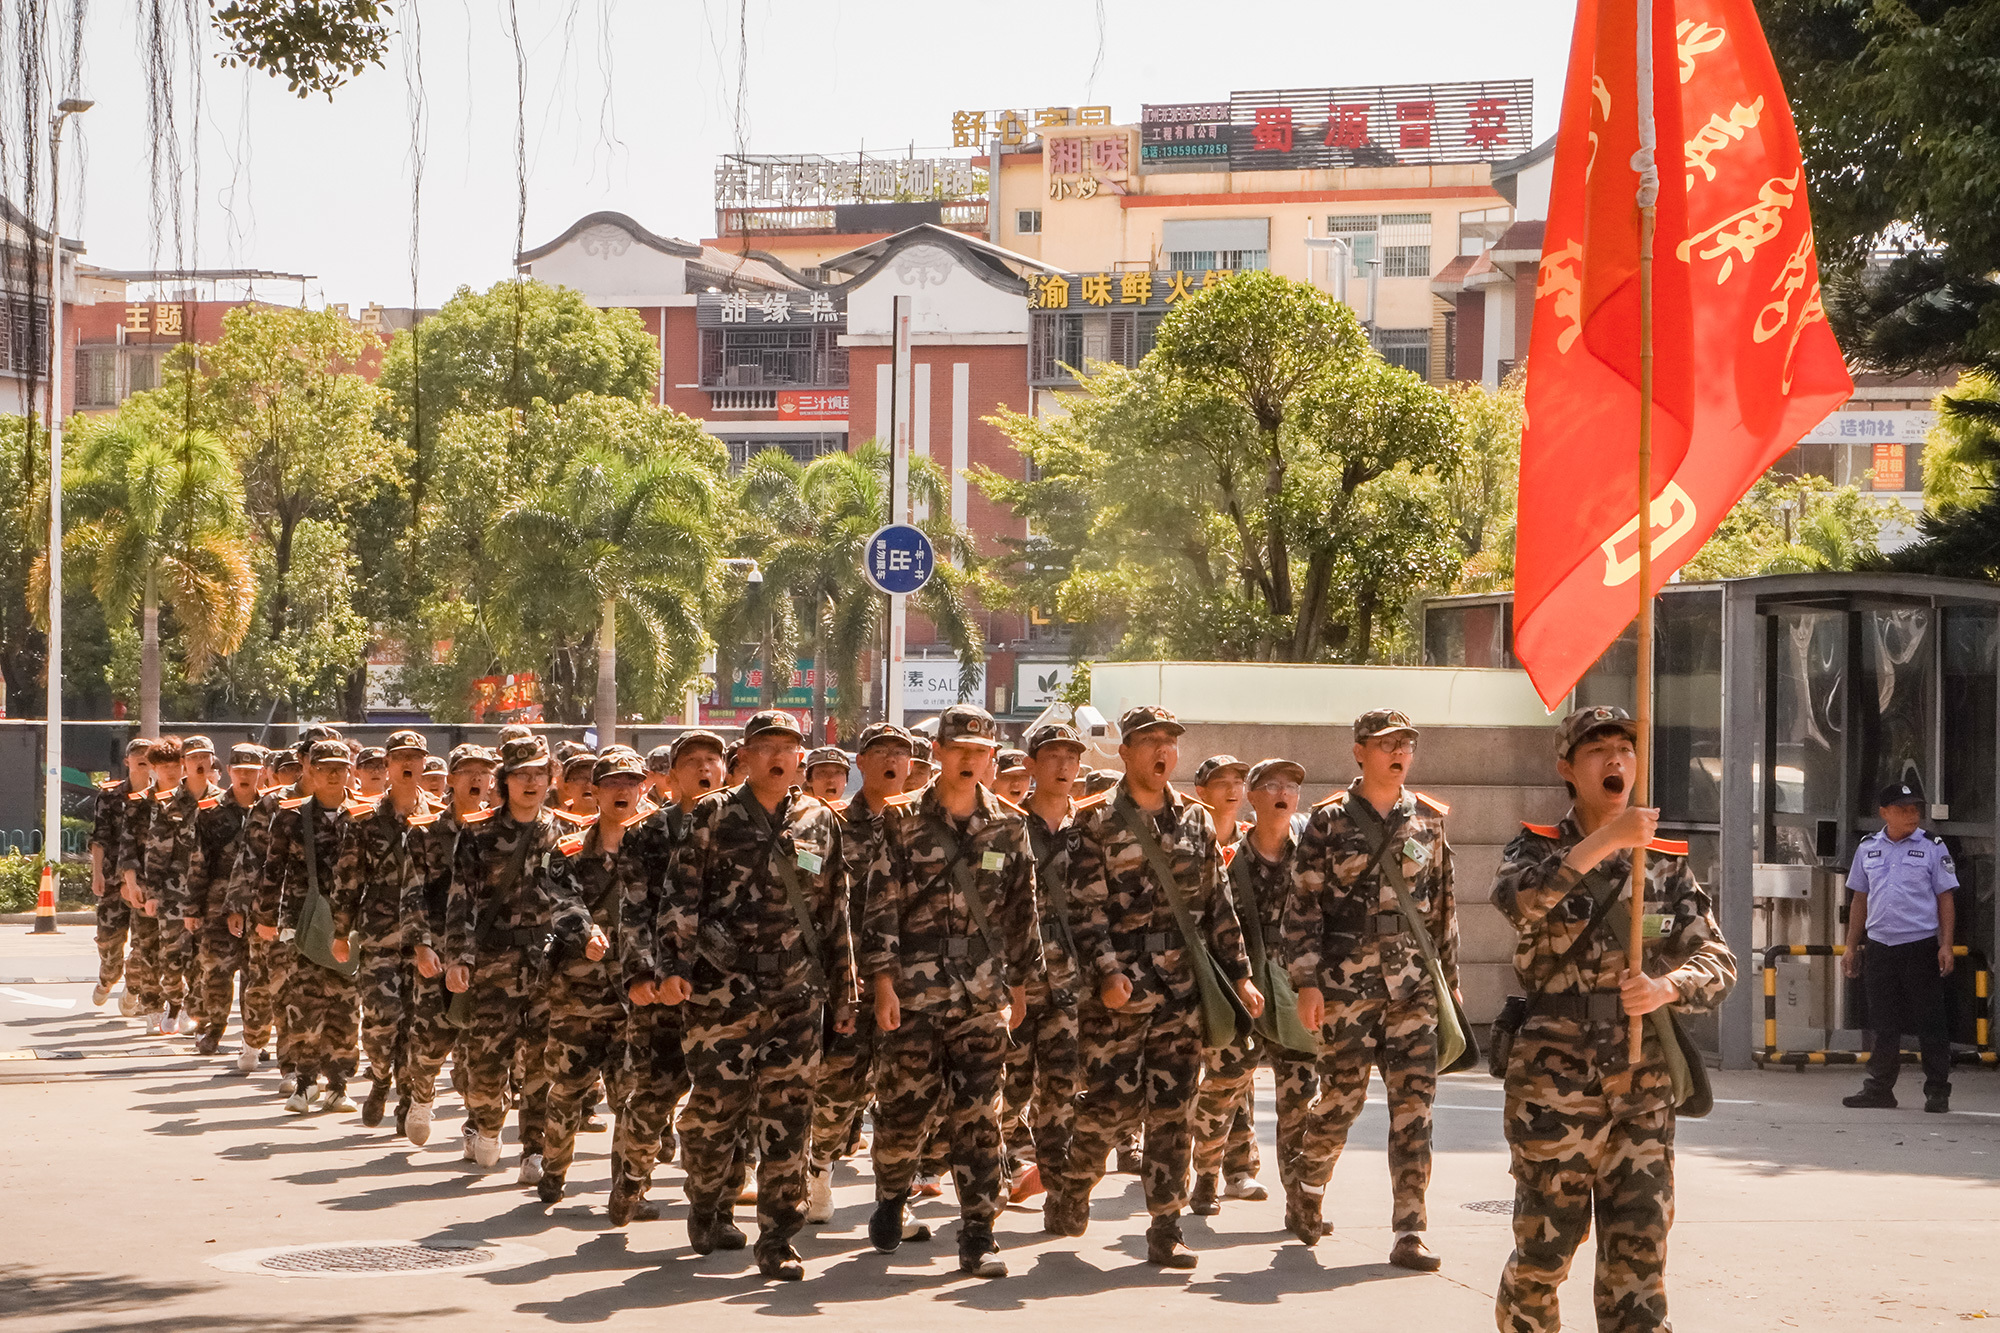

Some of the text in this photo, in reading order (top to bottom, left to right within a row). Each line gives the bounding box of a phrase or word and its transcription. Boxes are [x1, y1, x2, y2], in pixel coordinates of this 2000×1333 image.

[1152, 124, 1217, 141] 工程有限公司
[1251, 98, 1509, 152] 蜀源冒菜
[1050, 136, 1127, 174] 湘味
[1141, 143, 1228, 158] 电话:13959667858
[714, 158, 972, 200] 东北烧烤涮涮锅
[1050, 178, 1098, 200] 小炒
[1026, 273, 1040, 310] 重庆
[125, 302, 182, 336] 主题
[720, 292, 839, 323] 甜缘糕
[1839, 419, 1895, 437] 造物社
[1875, 459, 1903, 472] 招租
[876, 539, 887, 580] 请勿跟车
[889, 549, 912, 571] 出
[915, 540, 925, 580] 一车一杆
[904, 670, 924, 687] 素
